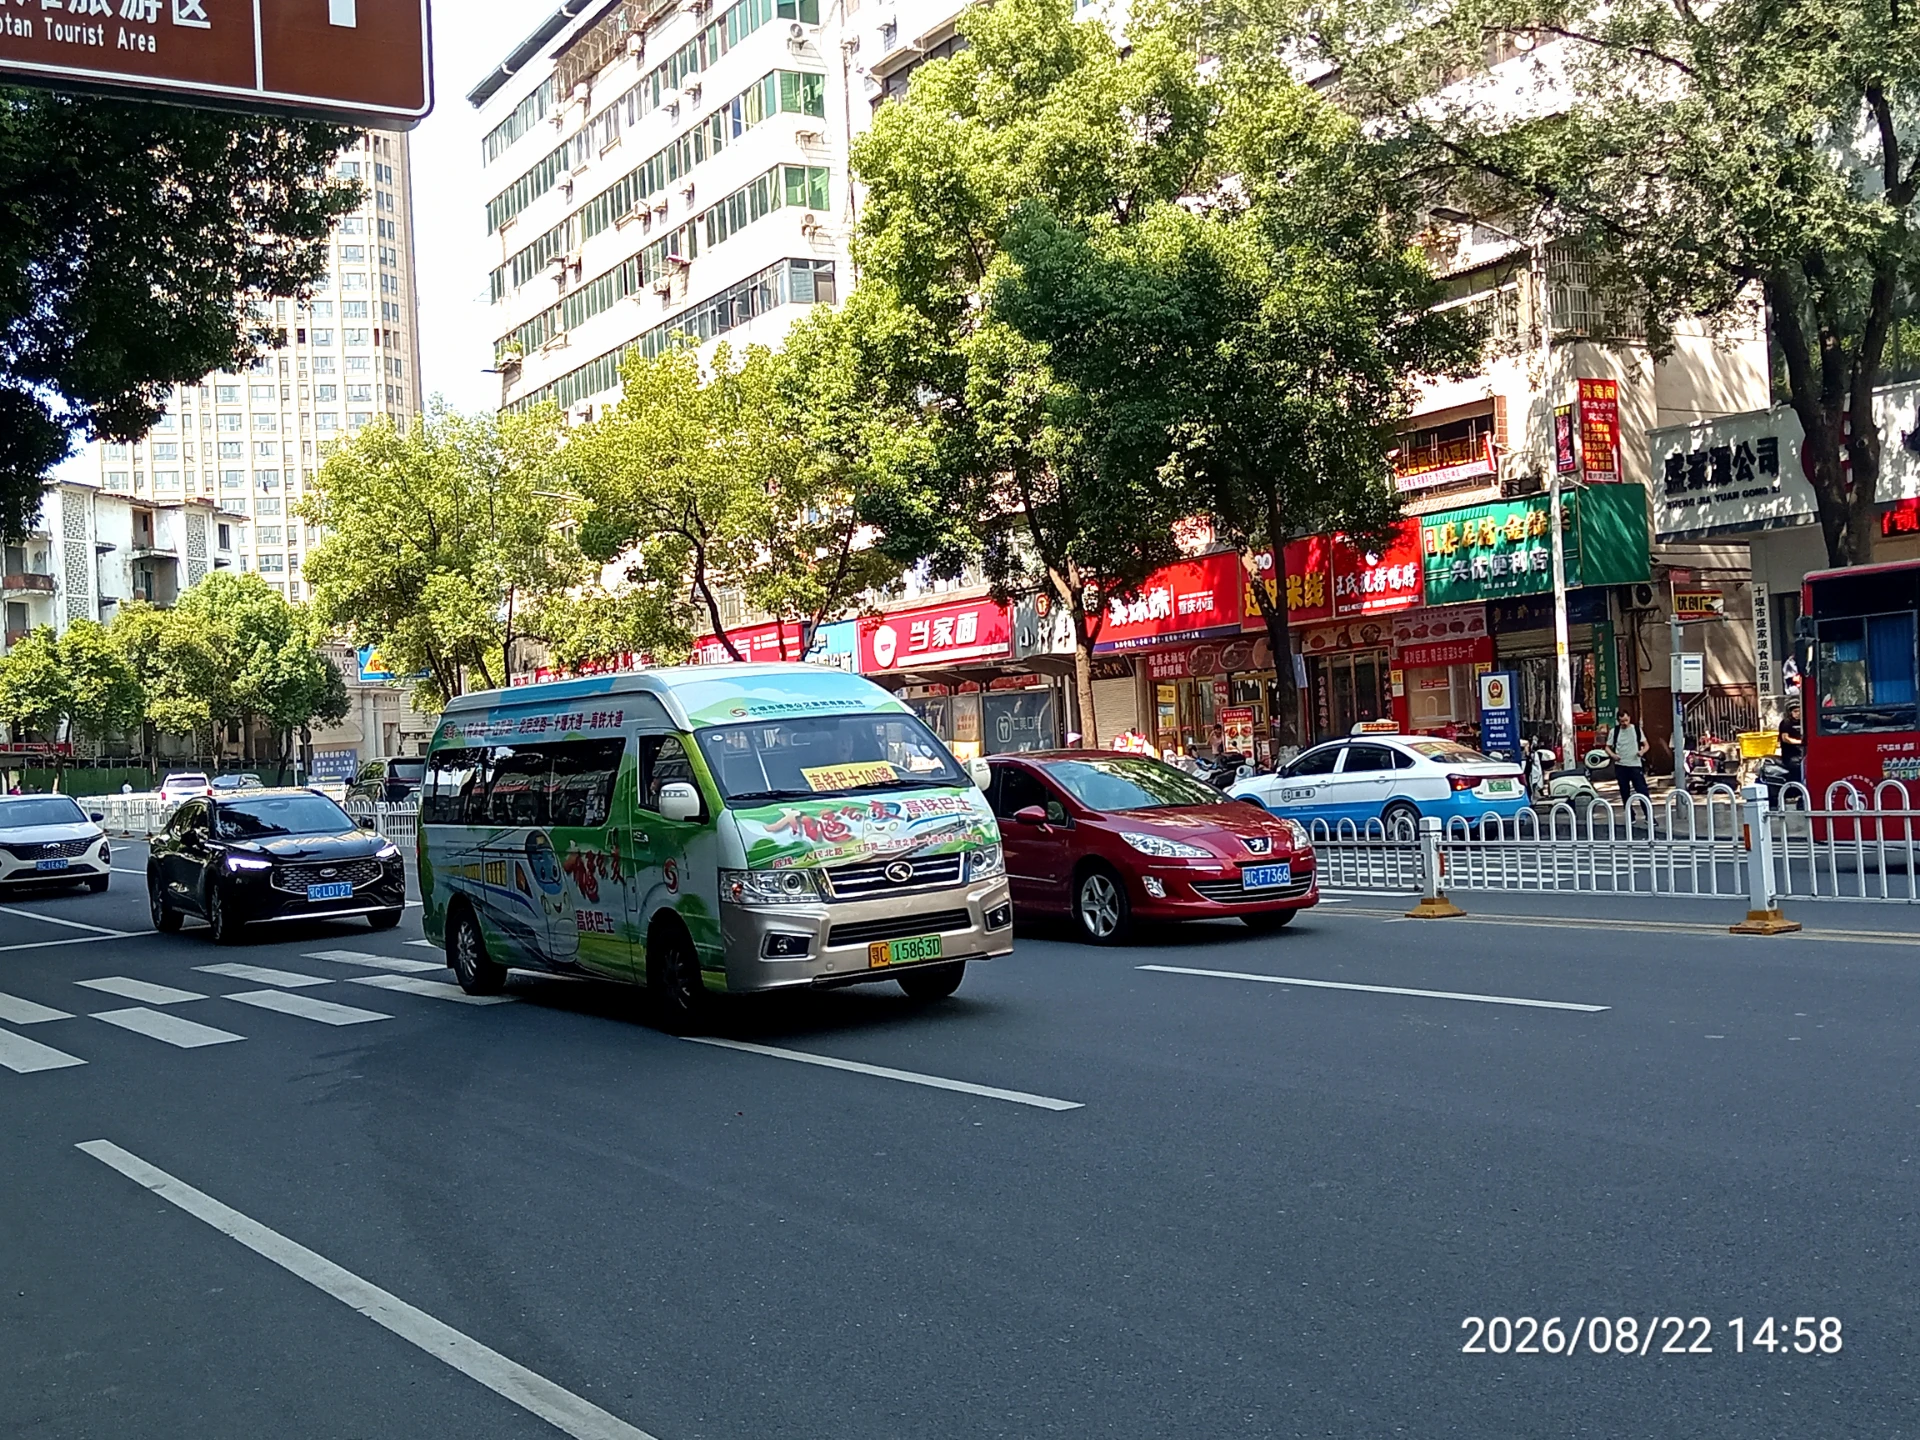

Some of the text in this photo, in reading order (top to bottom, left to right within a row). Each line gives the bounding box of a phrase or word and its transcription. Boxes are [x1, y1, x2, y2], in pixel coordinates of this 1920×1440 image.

[44, 17, 105, 47] Tourist
[117, 26, 157, 53] Area
[1664, 437, 1779, 495] 盛家源公司
[1714, 491, 1739, 502] YUAN
[1742, 487, 1769, 498] GONG
[1451, 546, 1549, 582] 兴优便利店
[1178, 597, 1213, 615] 重庆小面
[909, 612, 979, 651] 当家面
[1753, 586, 1771, 696] 十堰市盛家源食品有限
[902, 797, 973, 814] 高铁巴士
[576, 909, 615, 934] 高铁巴士
